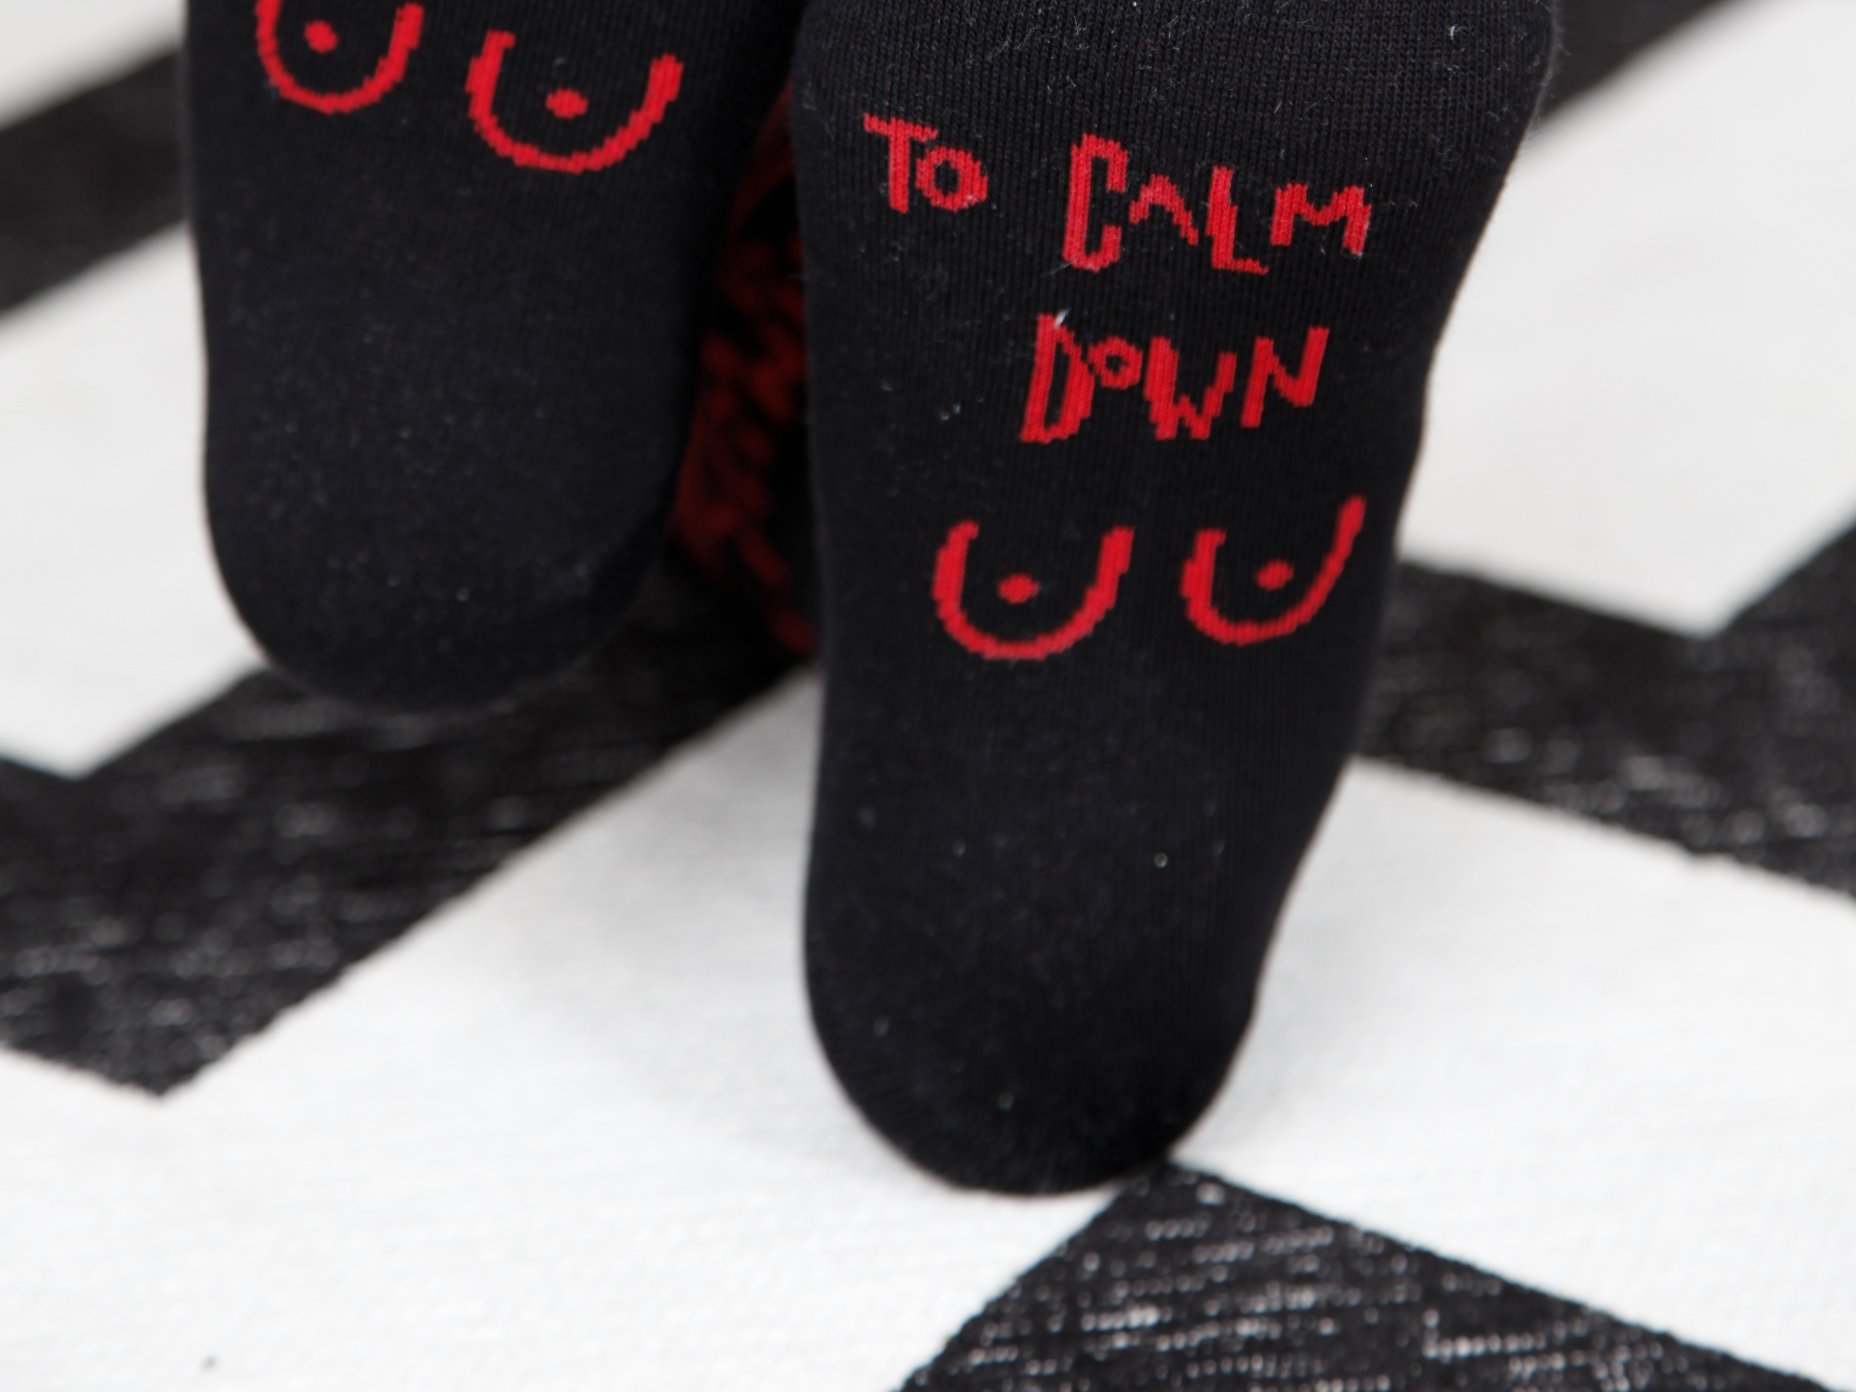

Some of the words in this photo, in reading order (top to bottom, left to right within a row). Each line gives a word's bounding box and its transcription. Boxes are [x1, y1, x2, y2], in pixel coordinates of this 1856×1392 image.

[862, 112, 988, 214] TO
[1061, 131, 1373, 275] CALM
[1020, 312, 1330, 445] DOWN
